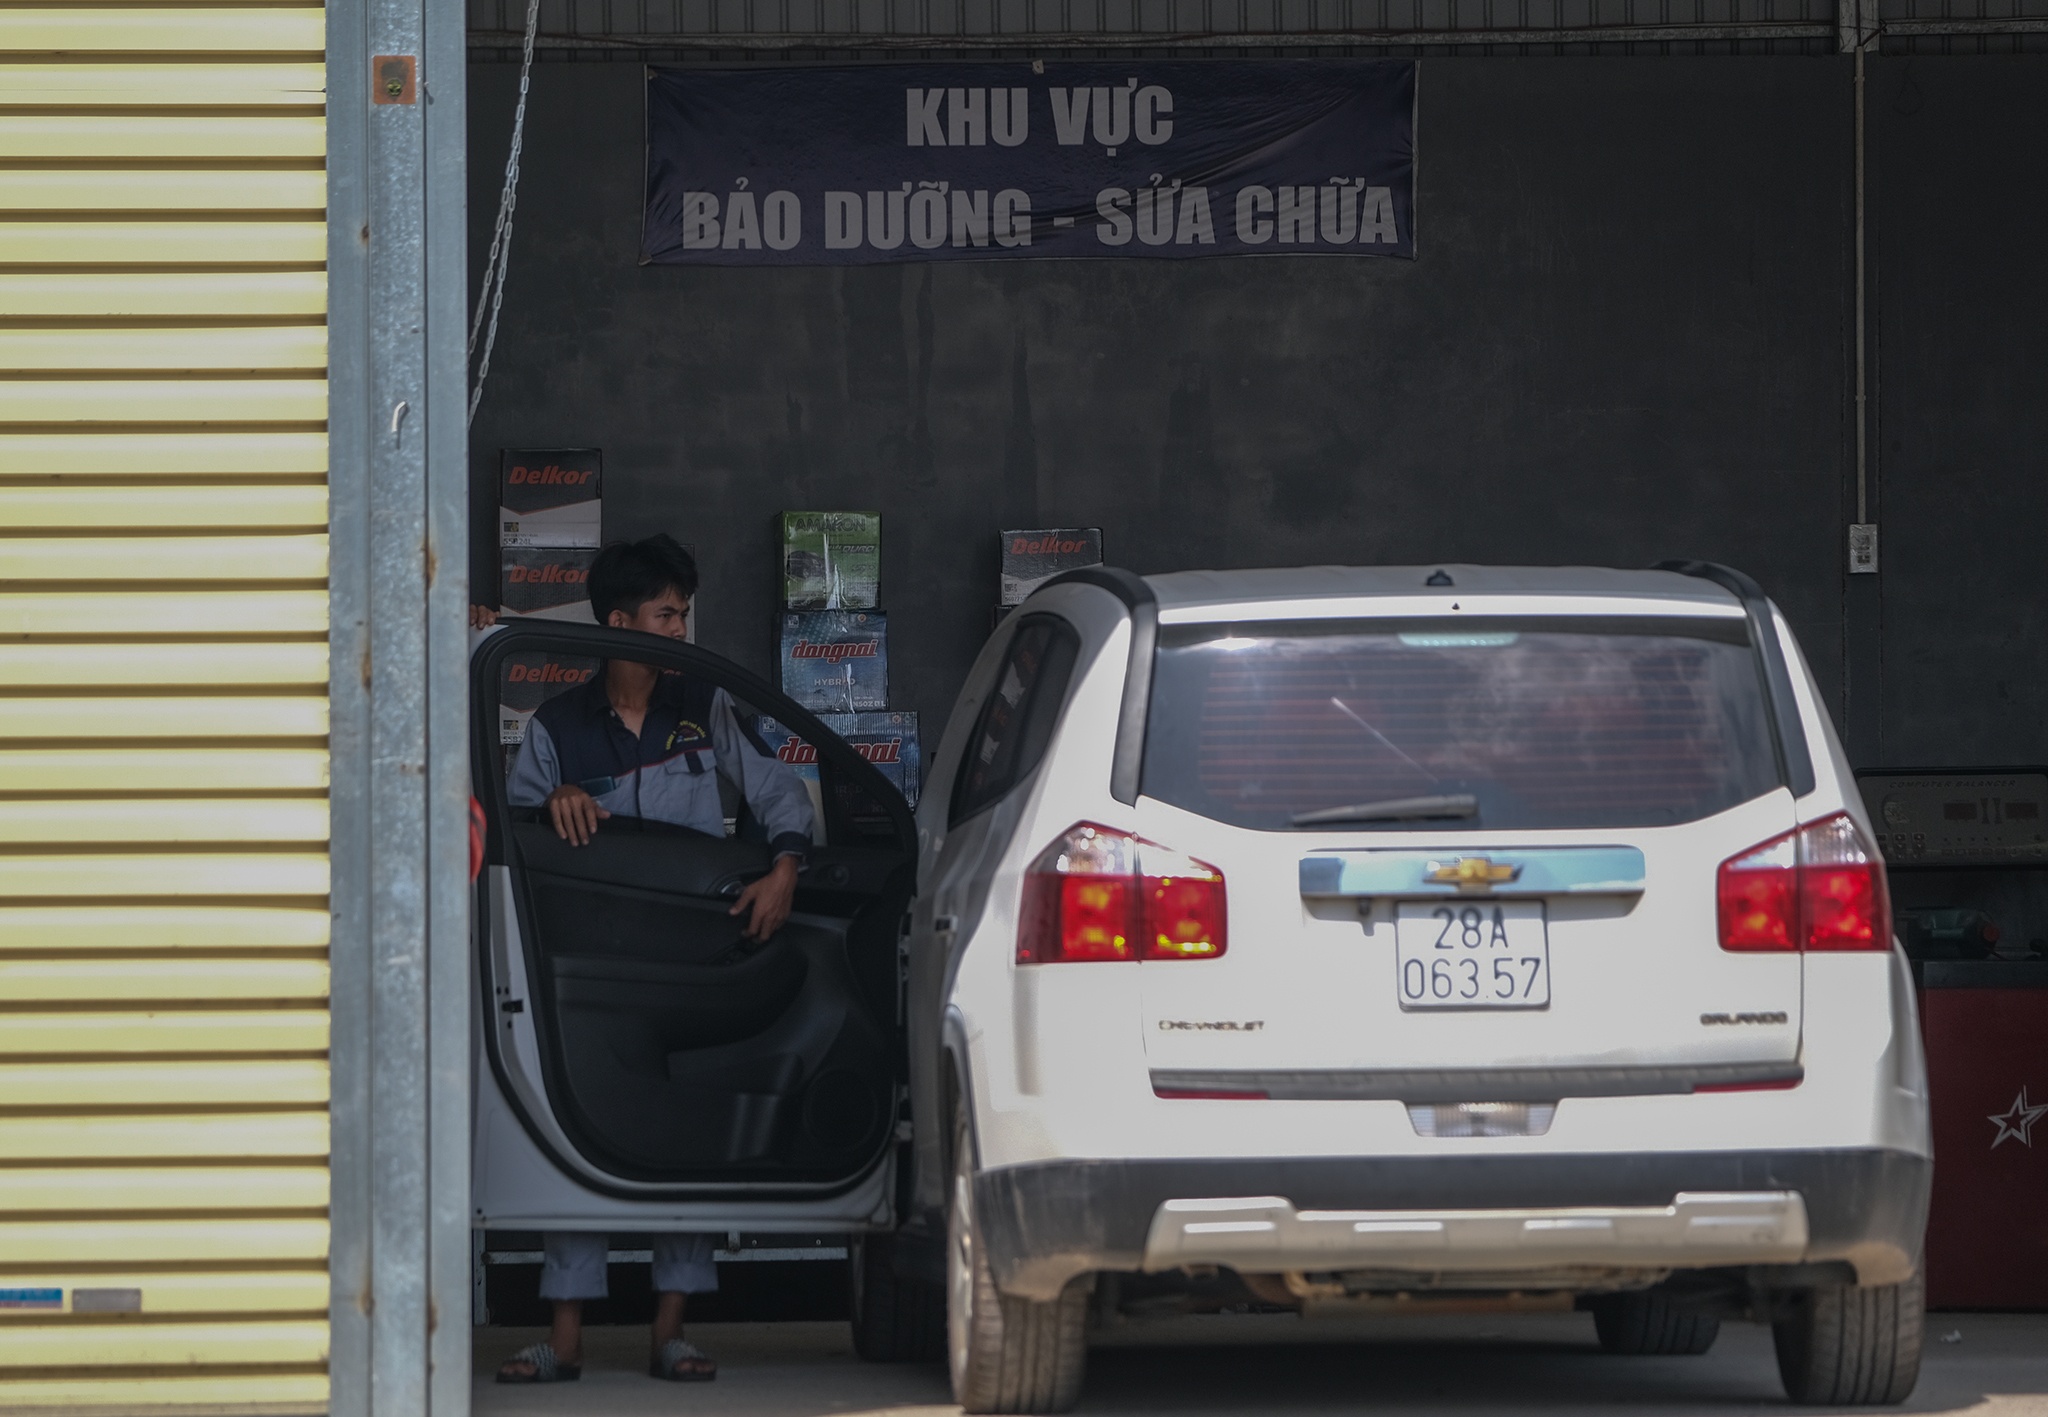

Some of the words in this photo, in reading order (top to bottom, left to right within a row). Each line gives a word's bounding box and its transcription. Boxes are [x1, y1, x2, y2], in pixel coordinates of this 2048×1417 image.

[905, 86, 1029, 147] KHU
[1050, 77, 1174, 157] VỰC
[682, 177, 801, 251] BẢO
[824, 181, 1032, 250] DƯỠNG
[1095, 172, 1217, 248] SỬA
[1236, 177, 1399, 246] CHỮA
[508, 465, 593, 485] Delkor
[1011, 536, 1087, 555] Delkor
[508, 663, 593, 683] Delkor
[1889, 780, 1951, 789] COMPUTER
[1955, 779, 2016, 788] BALANCER
[1432, 907, 1509, 949] 28A
[1402, 958, 1542, 1000] 063.57
